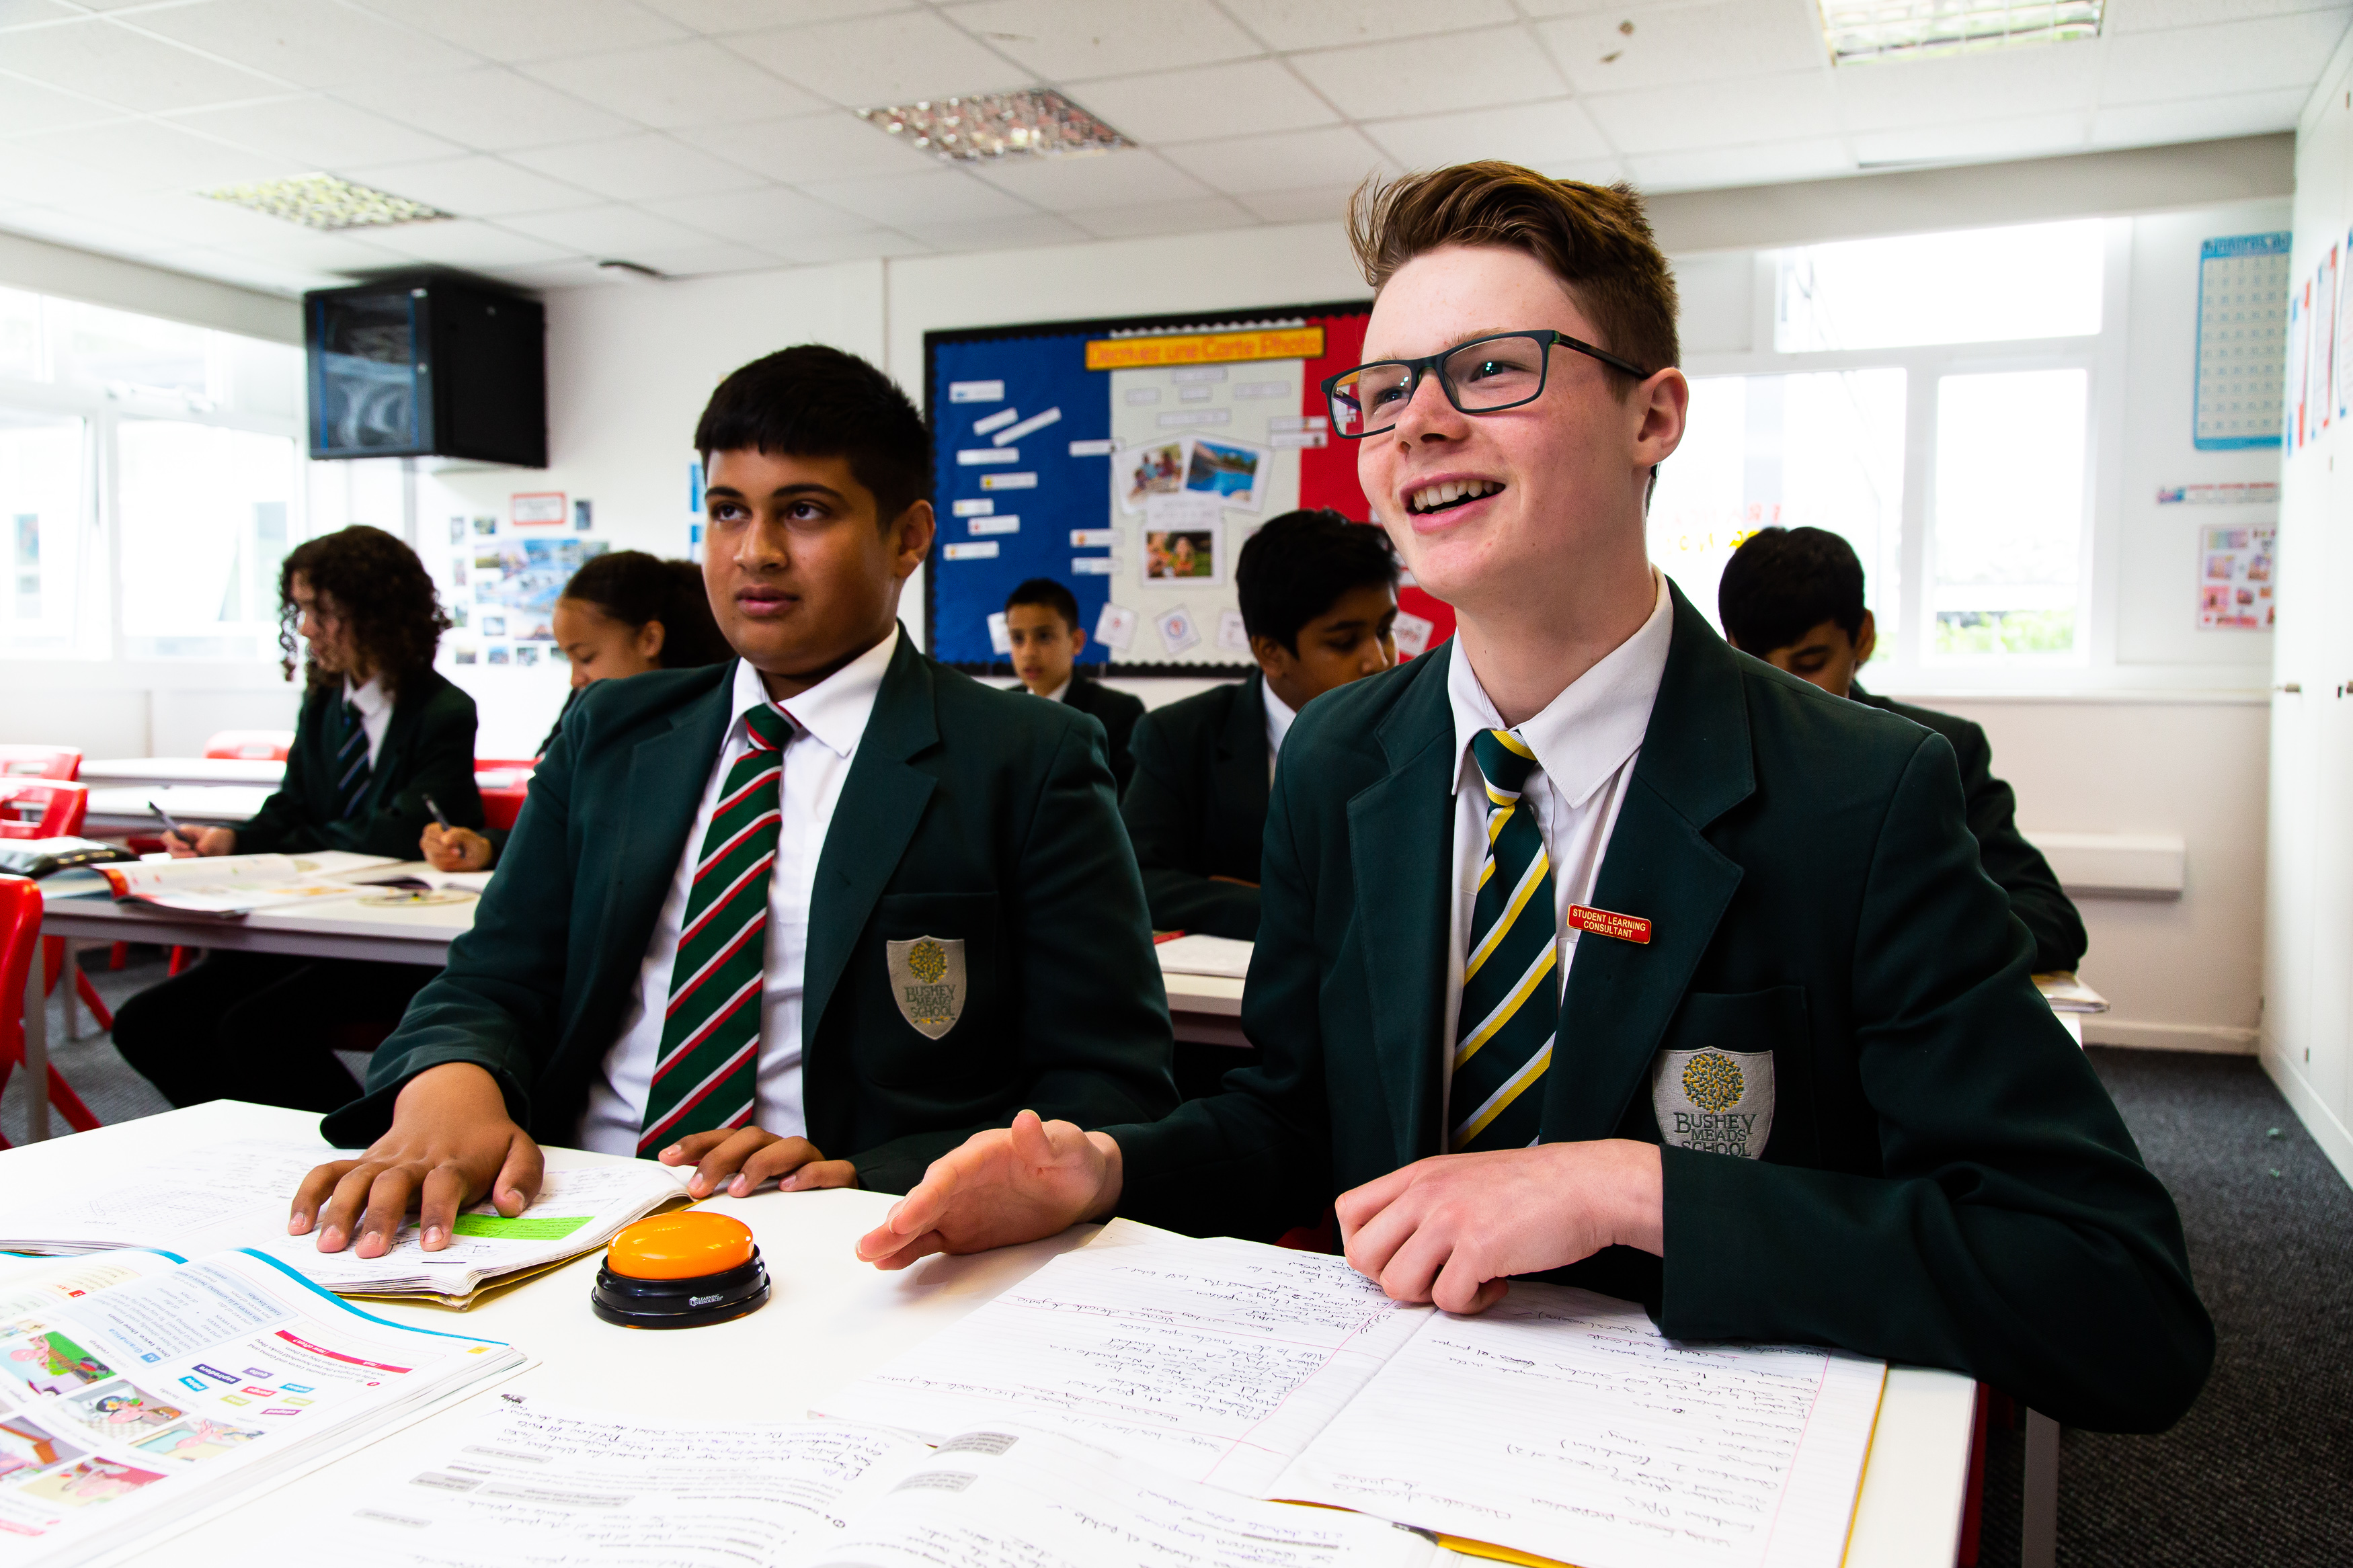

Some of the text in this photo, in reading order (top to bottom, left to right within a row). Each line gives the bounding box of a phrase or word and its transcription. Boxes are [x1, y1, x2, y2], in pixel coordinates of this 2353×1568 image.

[1572, 908, 1646, 932] STUDENT LEARNING
[1583, 920, 1633, 938] CONSULTANT
[904, 984, 956, 1002] BUSHEY
[1673, 1111, 1759, 1134] BUSHEY
[1691, 1128, 1747, 1143] MEADS
[212, 1270, 227, 1280] every
[258, 1300, 268, 1308] los
[239, 1305, 253, 1316] veces
[268, 1305, 282, 1316] todos
[108, 1313, 124, 1324] times
[253, 1315, 263, 1323] dos
[1158, 1329, 1184, 1337] que
[108, 1329, 143, 1353] Gramática
[255, 1339, 268, 1348] they
[1191, 1333, 1232, 1345] mucho
[1252, 1344, 1271, 1352] do
[199, 1366, 236, 1382] aspiradora
[249, 1369, 268, 1377] quito
[1690, 1371, 1707, 1379] 16
[247, 1387, 272, 1395] pongo
[1240, 1387, 1266, 1396] did
[1192, 1394, 1209, 1402] to
[1233, 1393, 1277, 1408] music
[1179, 1402, 1227, 1416] teacher
[1236, 1410, 1261, 1421] My
[1735, 1418, 1802, 1434] Question
[1717, 1442, 1791, 1458] Question
[1697, 1467, 1778, 1490] Question
